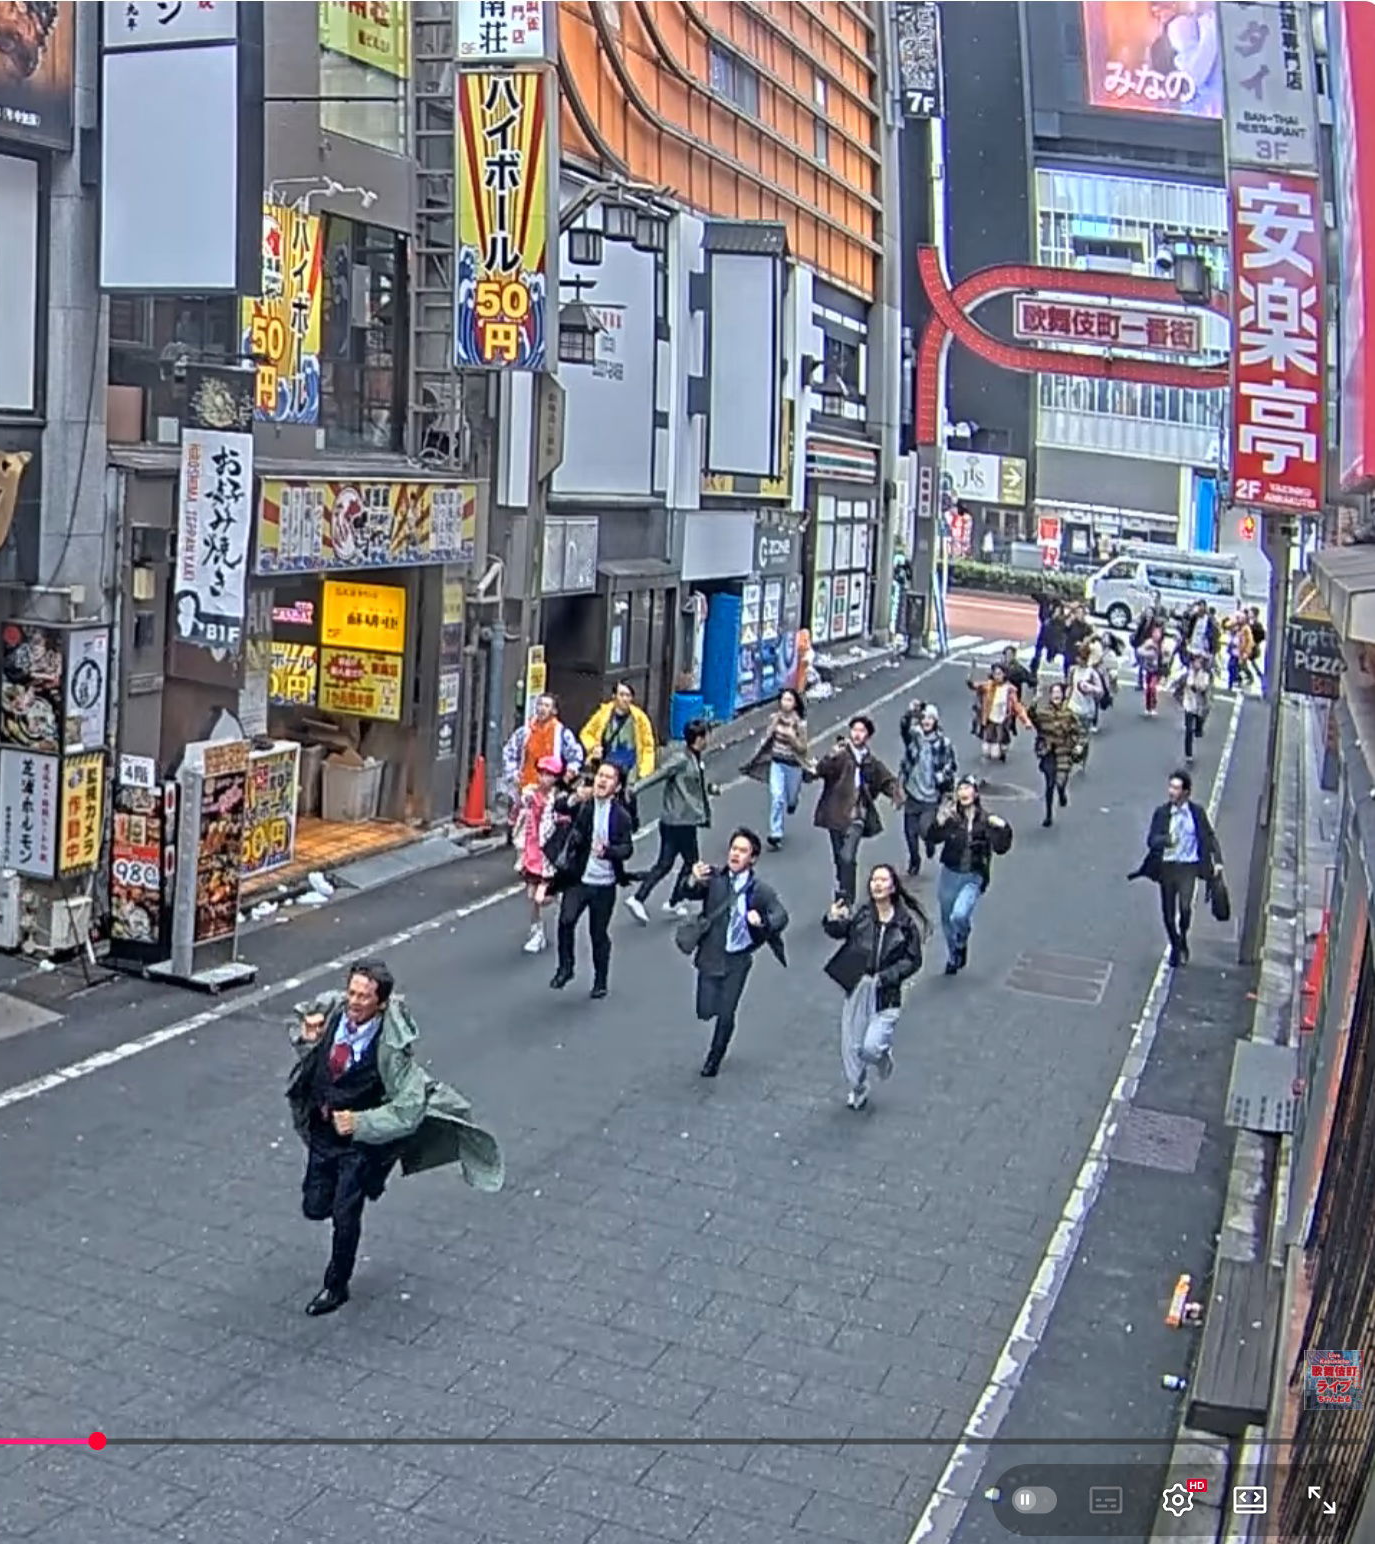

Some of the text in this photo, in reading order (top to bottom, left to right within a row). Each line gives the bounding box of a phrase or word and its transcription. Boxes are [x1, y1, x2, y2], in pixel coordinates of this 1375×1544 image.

[1234, 20, 1270, 101] タイ
[907, 91, 935, 113] 7F
[1105, 62, 1195, 102] みなの
[1256, 140, 1289, 161] 3F
[484, 78, 519, 273] ハイボール
[290, 212, 312, 413] ハイボール
[1023, 304, 1194, 348] 歌舞伎町一番街
[1237, 183, 1318, 475] 安楽亭
[1235, 478, 1262, 500] 2F
[206, 623, 240, 645] B1F
[124, 764, 149, 784] 4階
